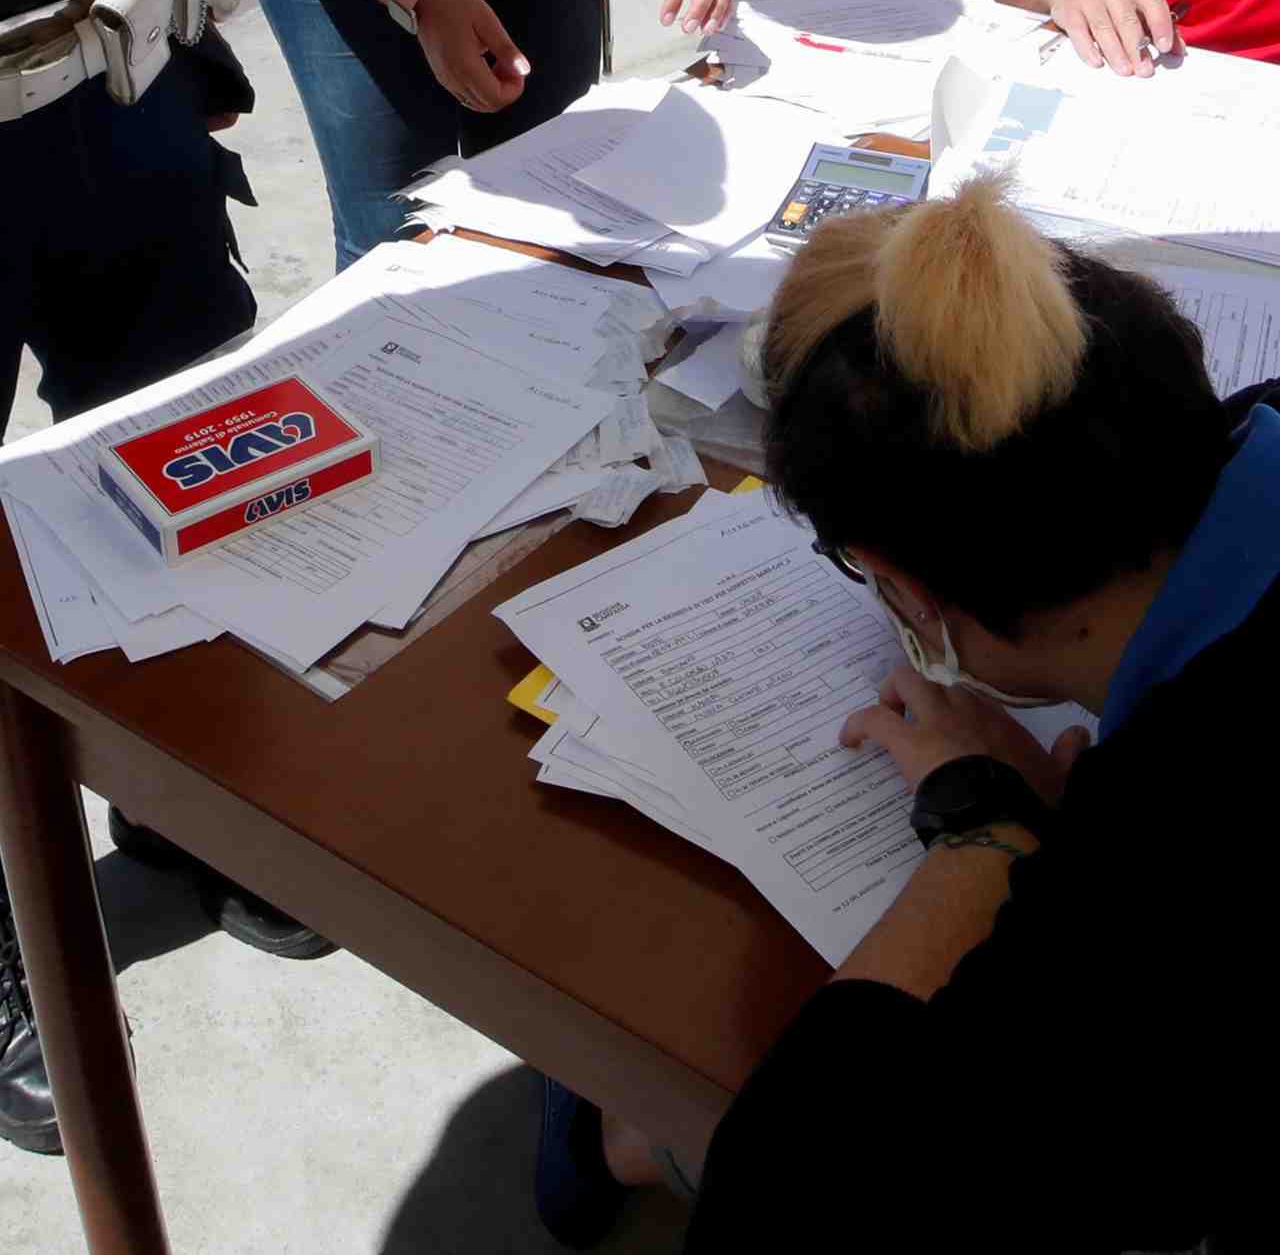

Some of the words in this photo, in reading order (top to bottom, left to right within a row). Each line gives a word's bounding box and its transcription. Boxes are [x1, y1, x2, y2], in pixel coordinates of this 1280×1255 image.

[224, 410, 256, 426] 1959
[184, 425, 217, 442] 2019
[162, 411, 316, 491] AVIS
[244, 479, 311, 523] AVIS
